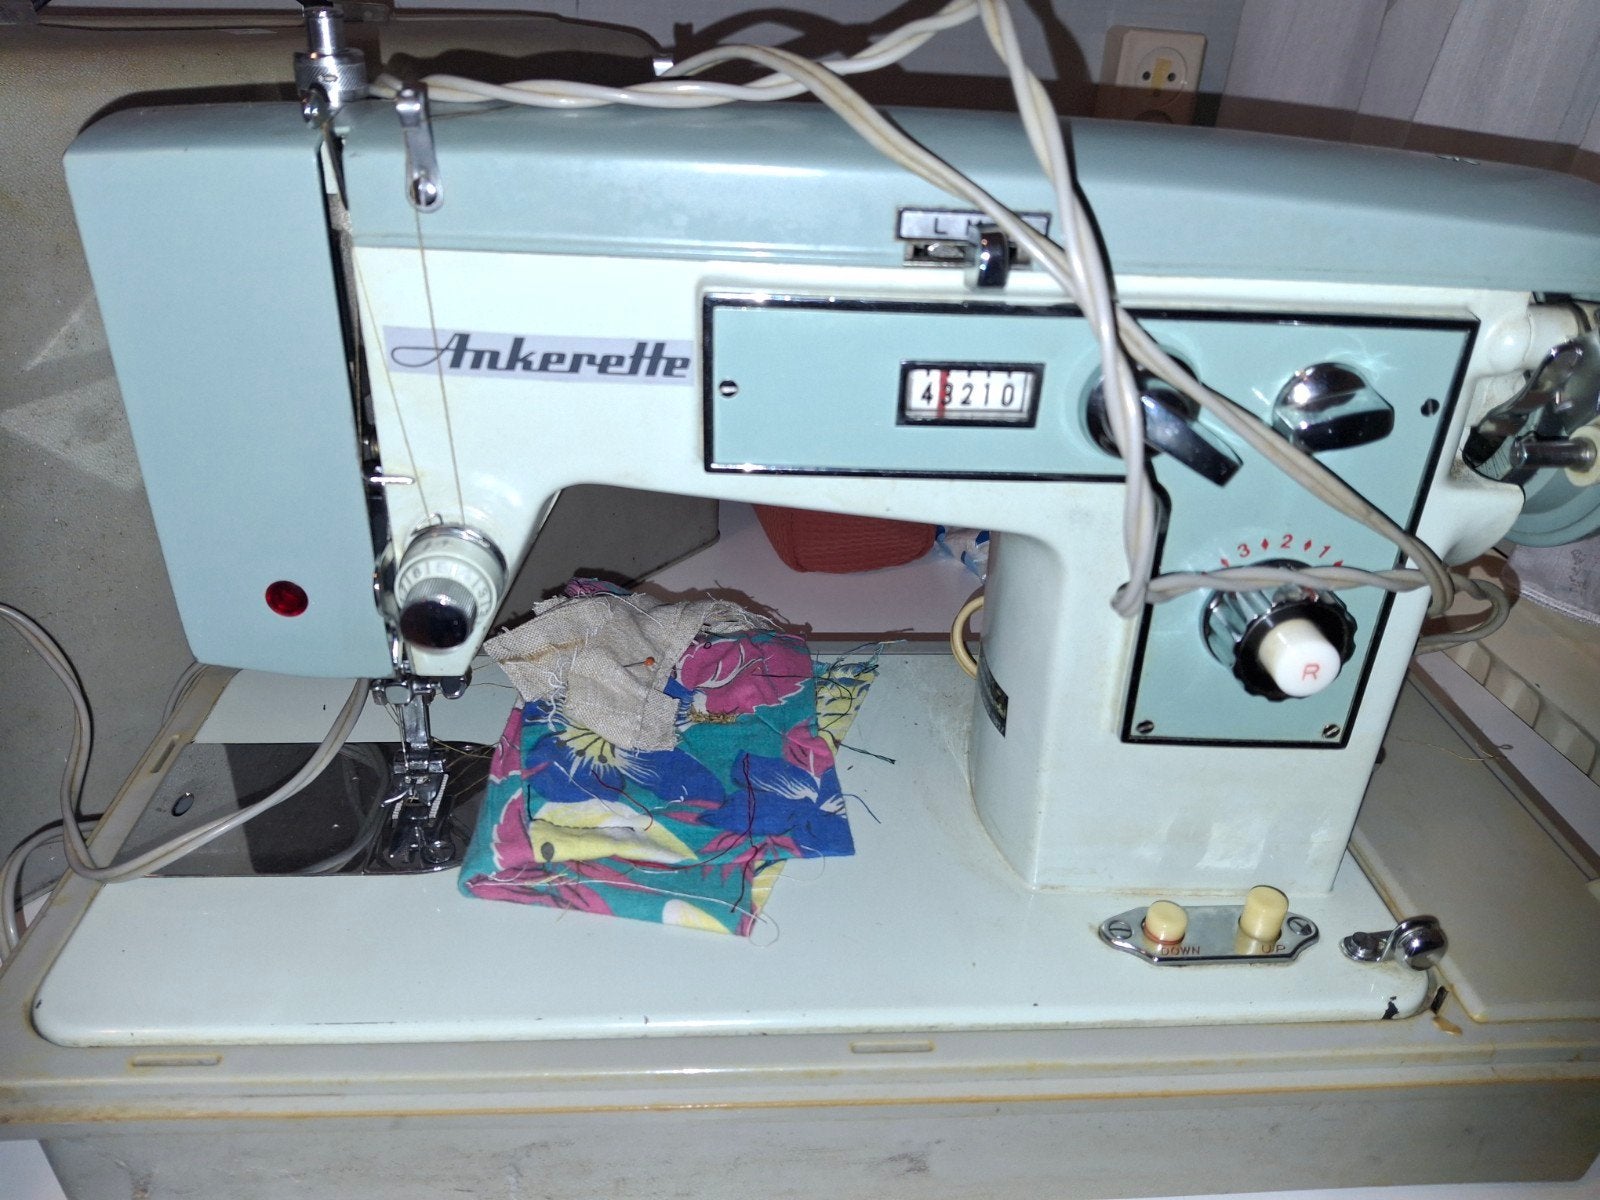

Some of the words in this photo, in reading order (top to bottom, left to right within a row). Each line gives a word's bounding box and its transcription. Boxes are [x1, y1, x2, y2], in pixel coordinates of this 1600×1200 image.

[934, 217, 947, 235] L
[390, 332, 691, 378] Ankerette
[1236, 542, 1251, 558] 3
[1279, 533, 1294, 549] 2
[1318, 545, 1332, 559] 1
[1301, 663, 1320, 681] R
[1161, 945, 1201, 956] DOWN
[1261, 943, 1286, 954] UP
